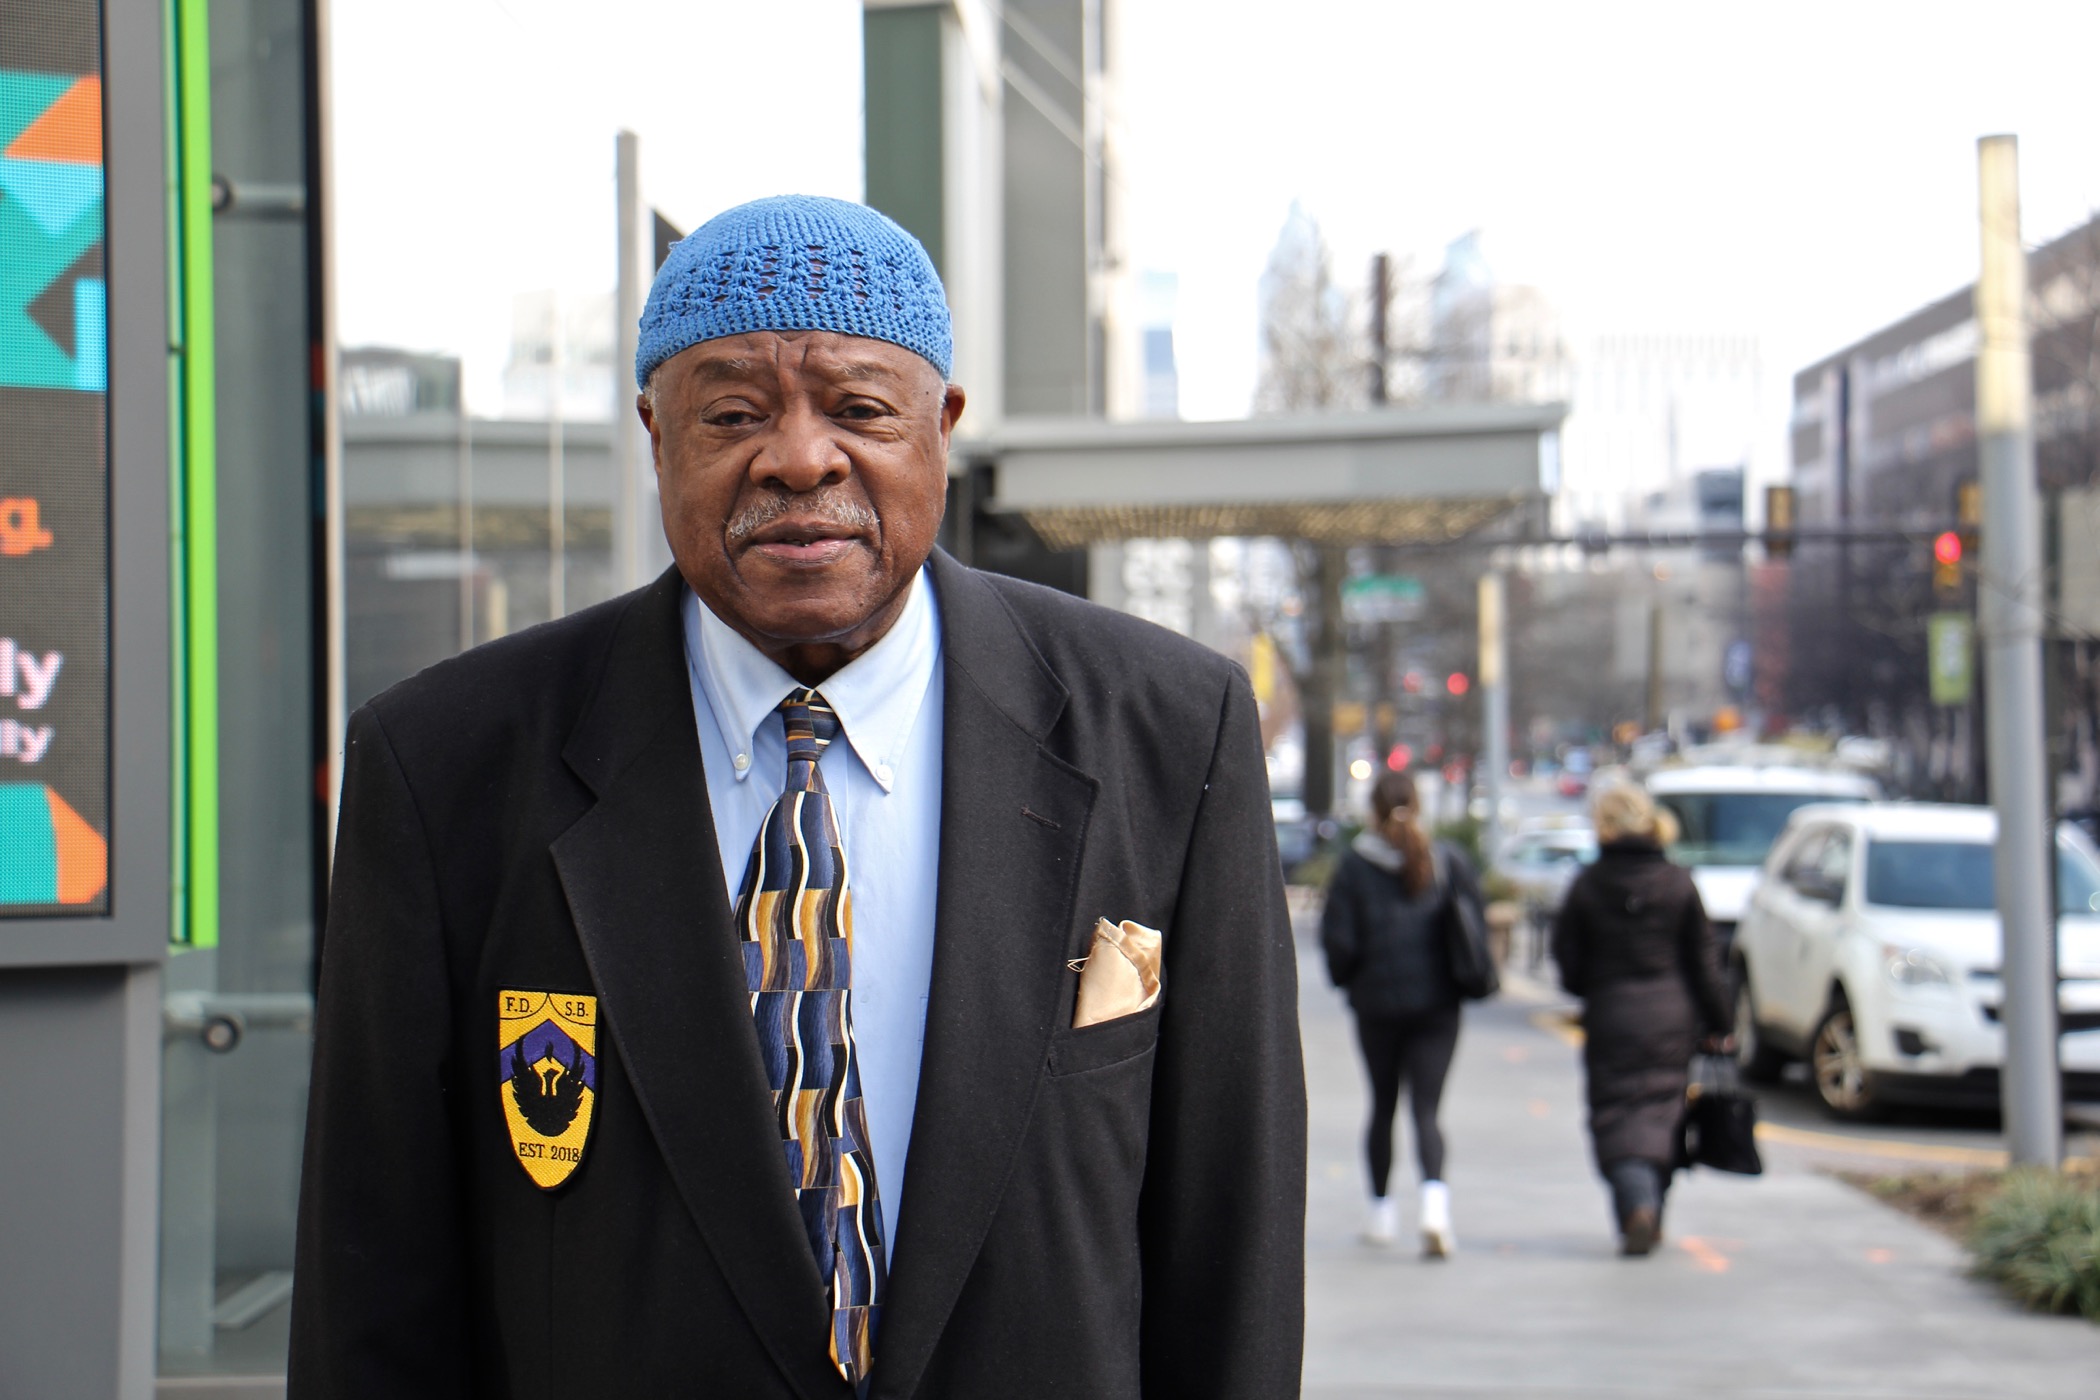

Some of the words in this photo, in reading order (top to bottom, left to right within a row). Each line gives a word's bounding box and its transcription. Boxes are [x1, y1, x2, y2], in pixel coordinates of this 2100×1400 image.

[505, 996, 532, 1013] F.D.
[565, 1001, 589, 1017] S.B.
[550, 1145, 581, 1163] 2018
